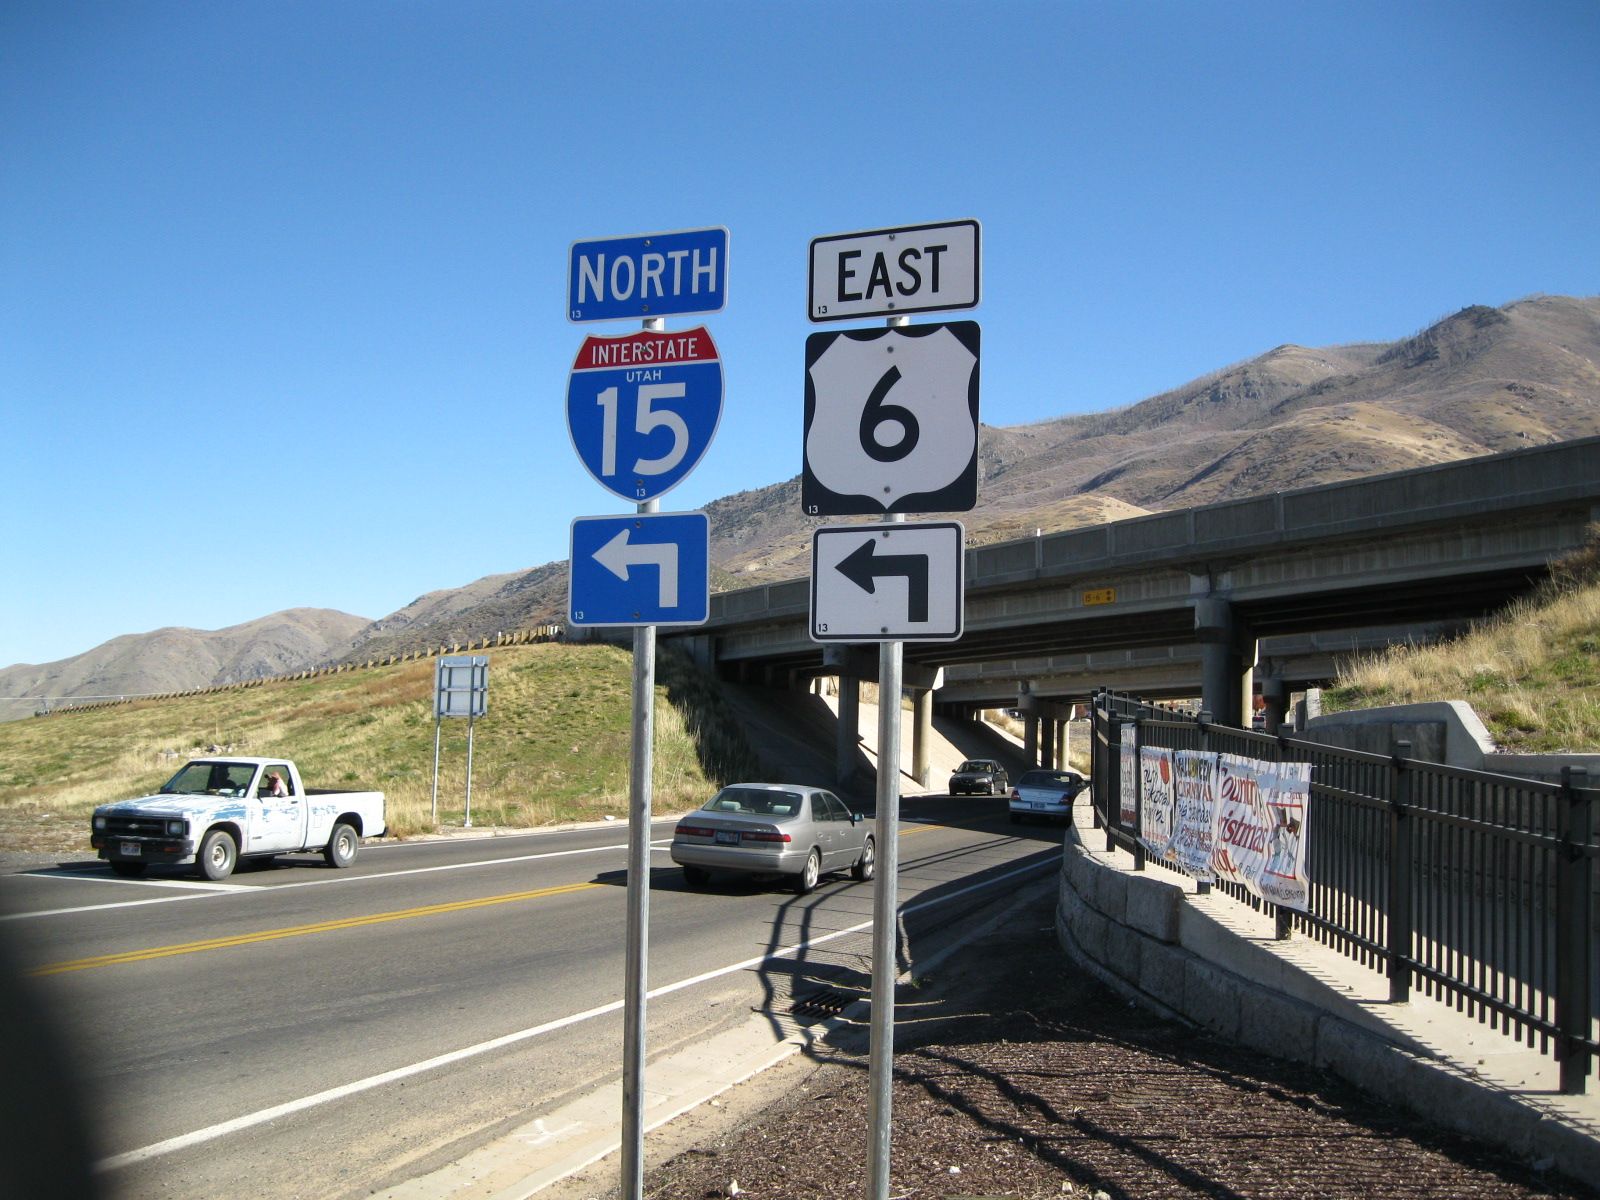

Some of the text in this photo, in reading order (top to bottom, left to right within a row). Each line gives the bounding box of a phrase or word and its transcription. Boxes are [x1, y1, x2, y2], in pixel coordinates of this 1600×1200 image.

[578, 247, 717, 304] NORTH
[838, 244, 948, 303] EAST
[571, 310, 582, 319] 13
[817, 305, 828, 314] 13
[592, 337, 698, 365] INTERSTATE
[626, 369, 662, 382] UTAH
[859, 365, 920, 463] 6
[596, 382, 690, 477] 15
[636, 488, 646, 497] 13
[808, 505, 819, 514] 13
[574, 611, 584, 620] 13
[818, 623, 829, 633] 13
